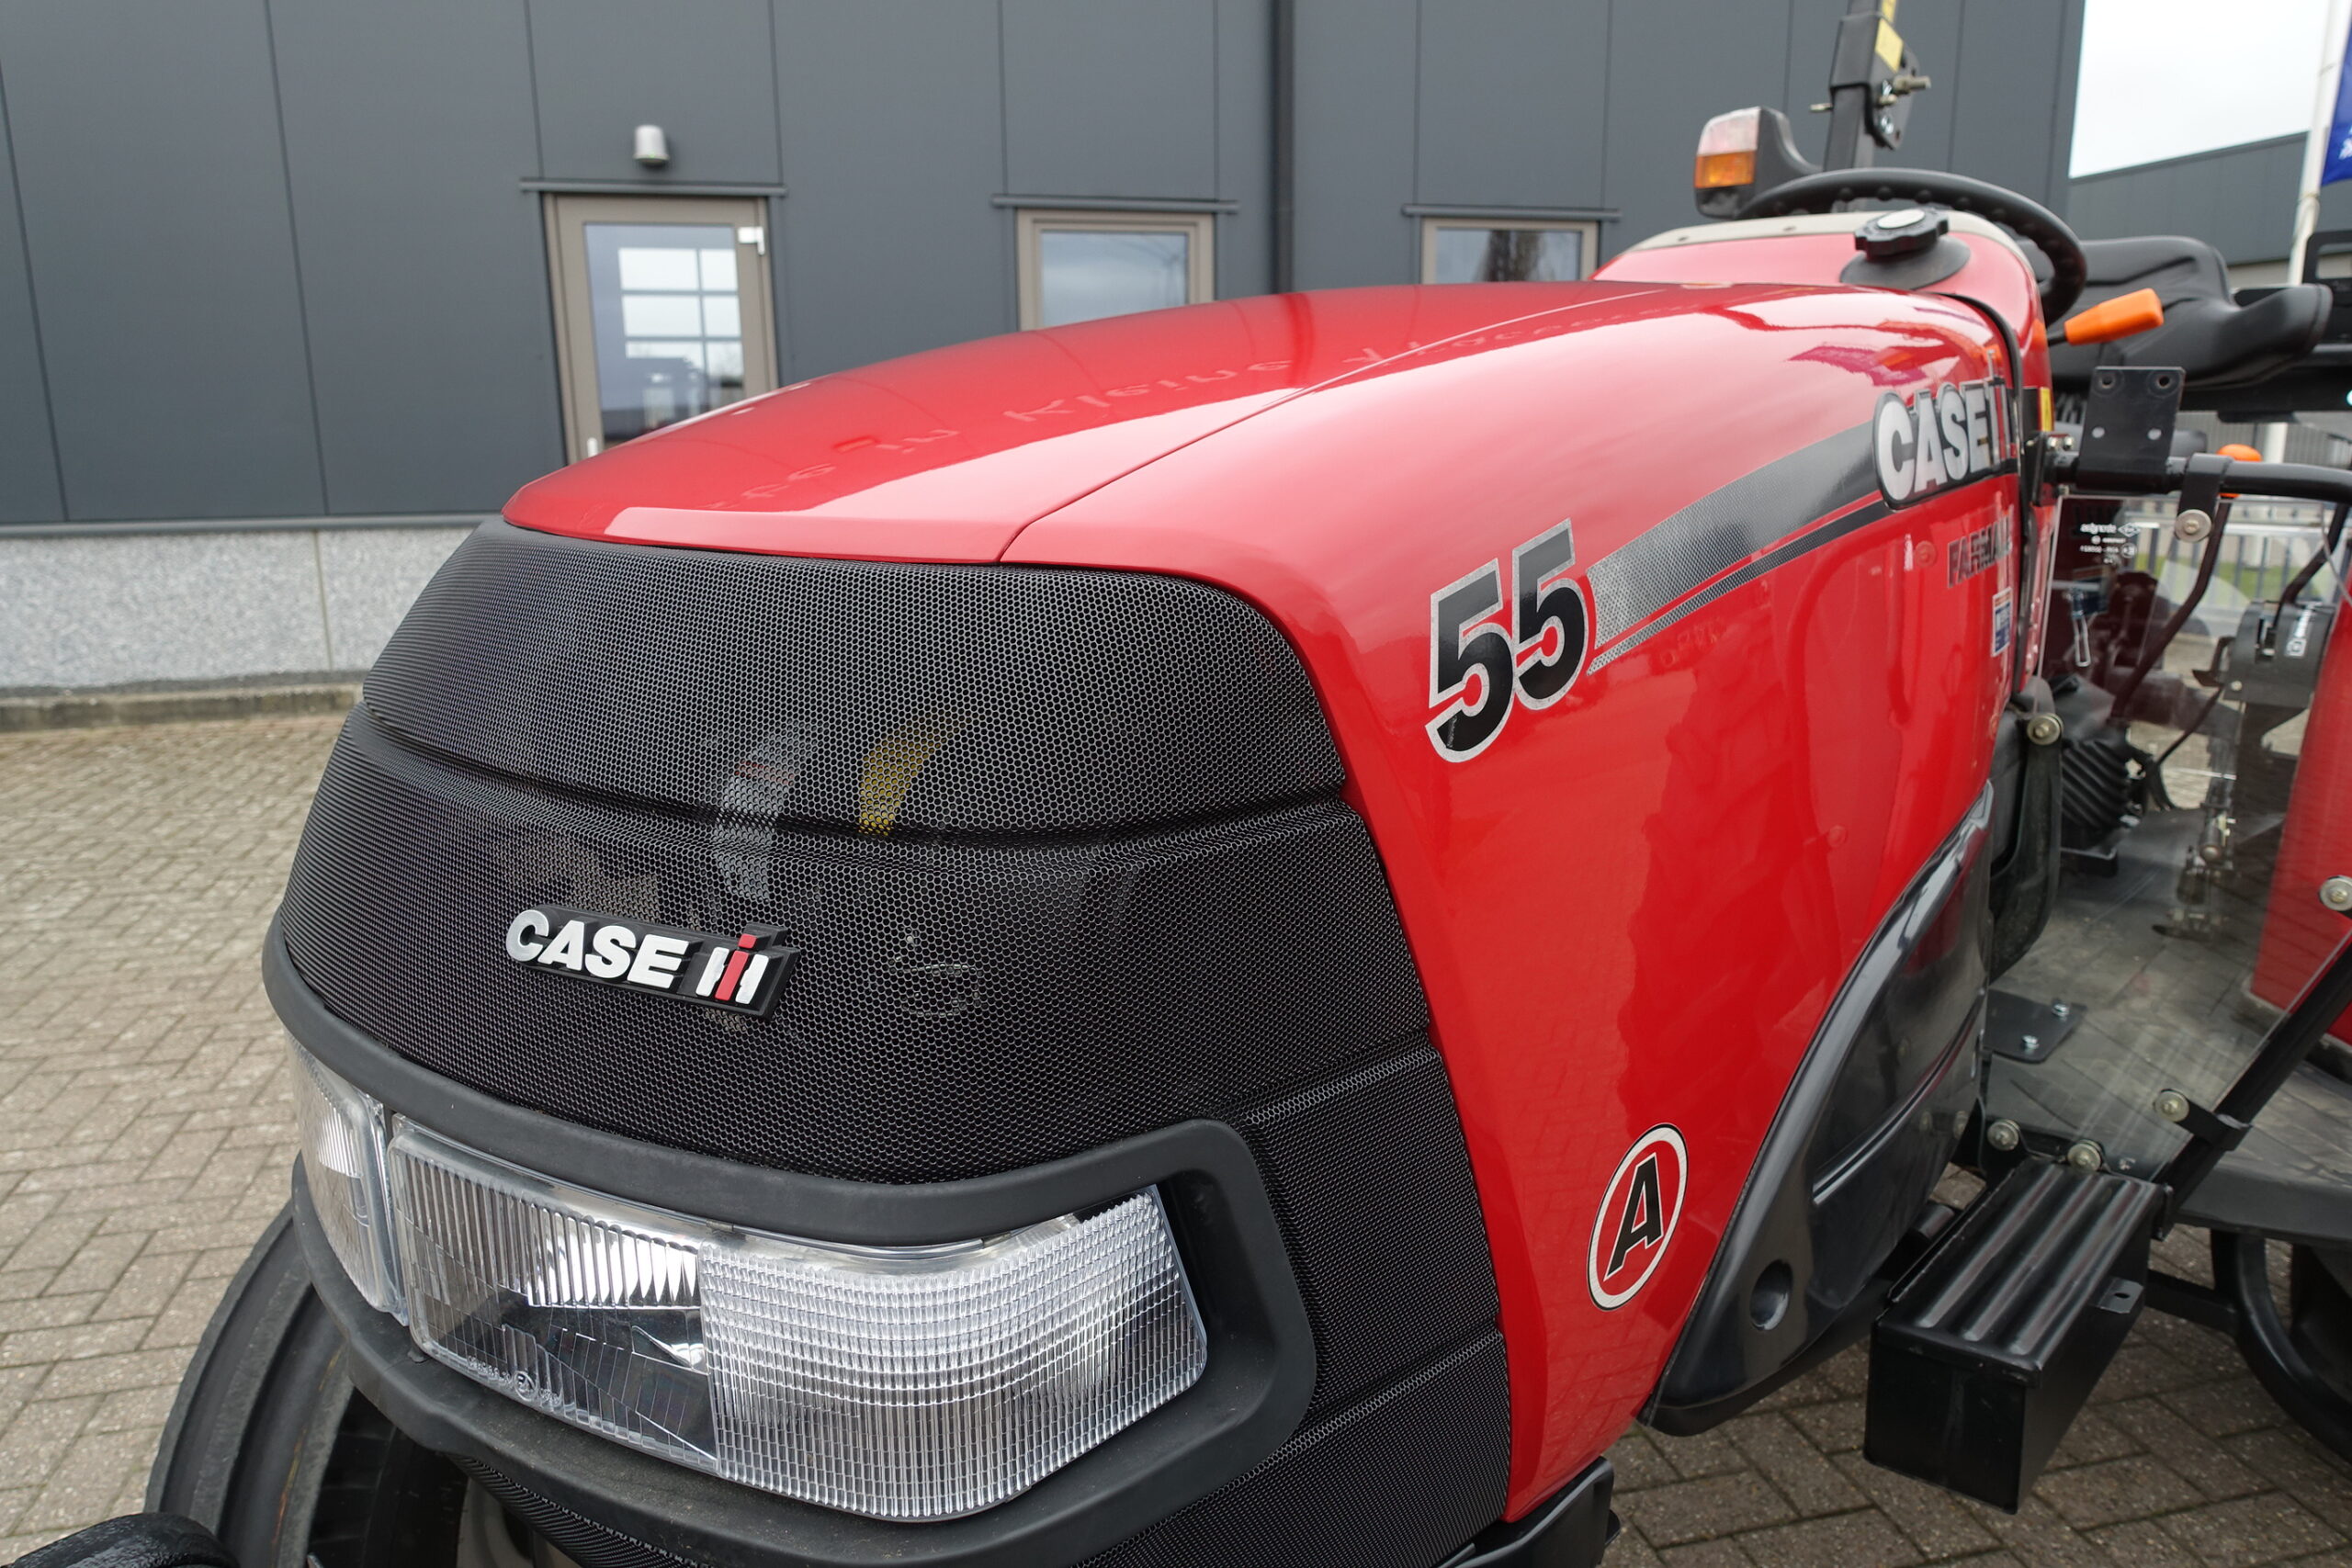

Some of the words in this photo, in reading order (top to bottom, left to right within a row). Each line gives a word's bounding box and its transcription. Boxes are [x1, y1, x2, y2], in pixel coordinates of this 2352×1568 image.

[1878, 387, 1992, 501] CASE
[1425, 517, 1589, 762] 55
[505, 909, 689, 989] CASE
[1603, 1152, 1664, 1282] A
